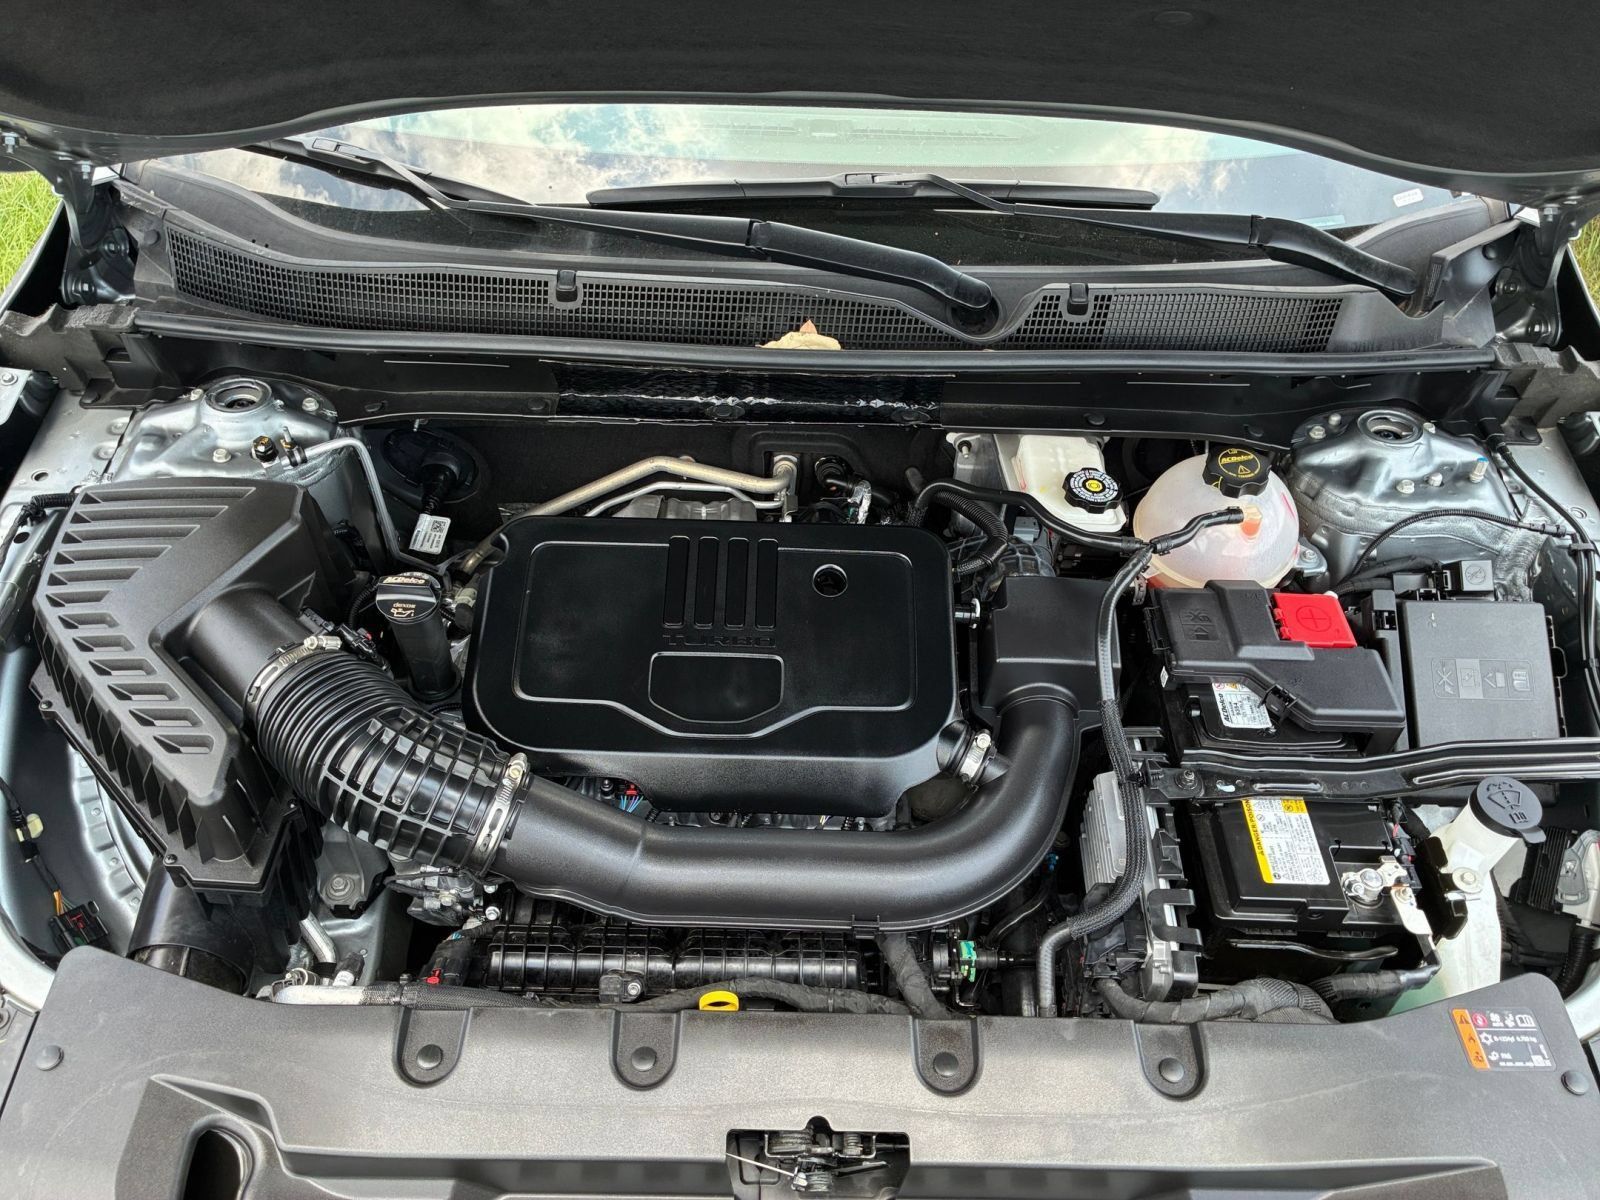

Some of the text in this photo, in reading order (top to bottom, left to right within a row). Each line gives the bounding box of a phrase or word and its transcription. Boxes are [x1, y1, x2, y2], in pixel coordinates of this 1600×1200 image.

[1221, 454, 1254, 465] ACDelco
[383, 576, 426, 584] ACDelco
[662, 634, 777, 648] TURBO
[1218, 693, 1230, 724] ACDelco
